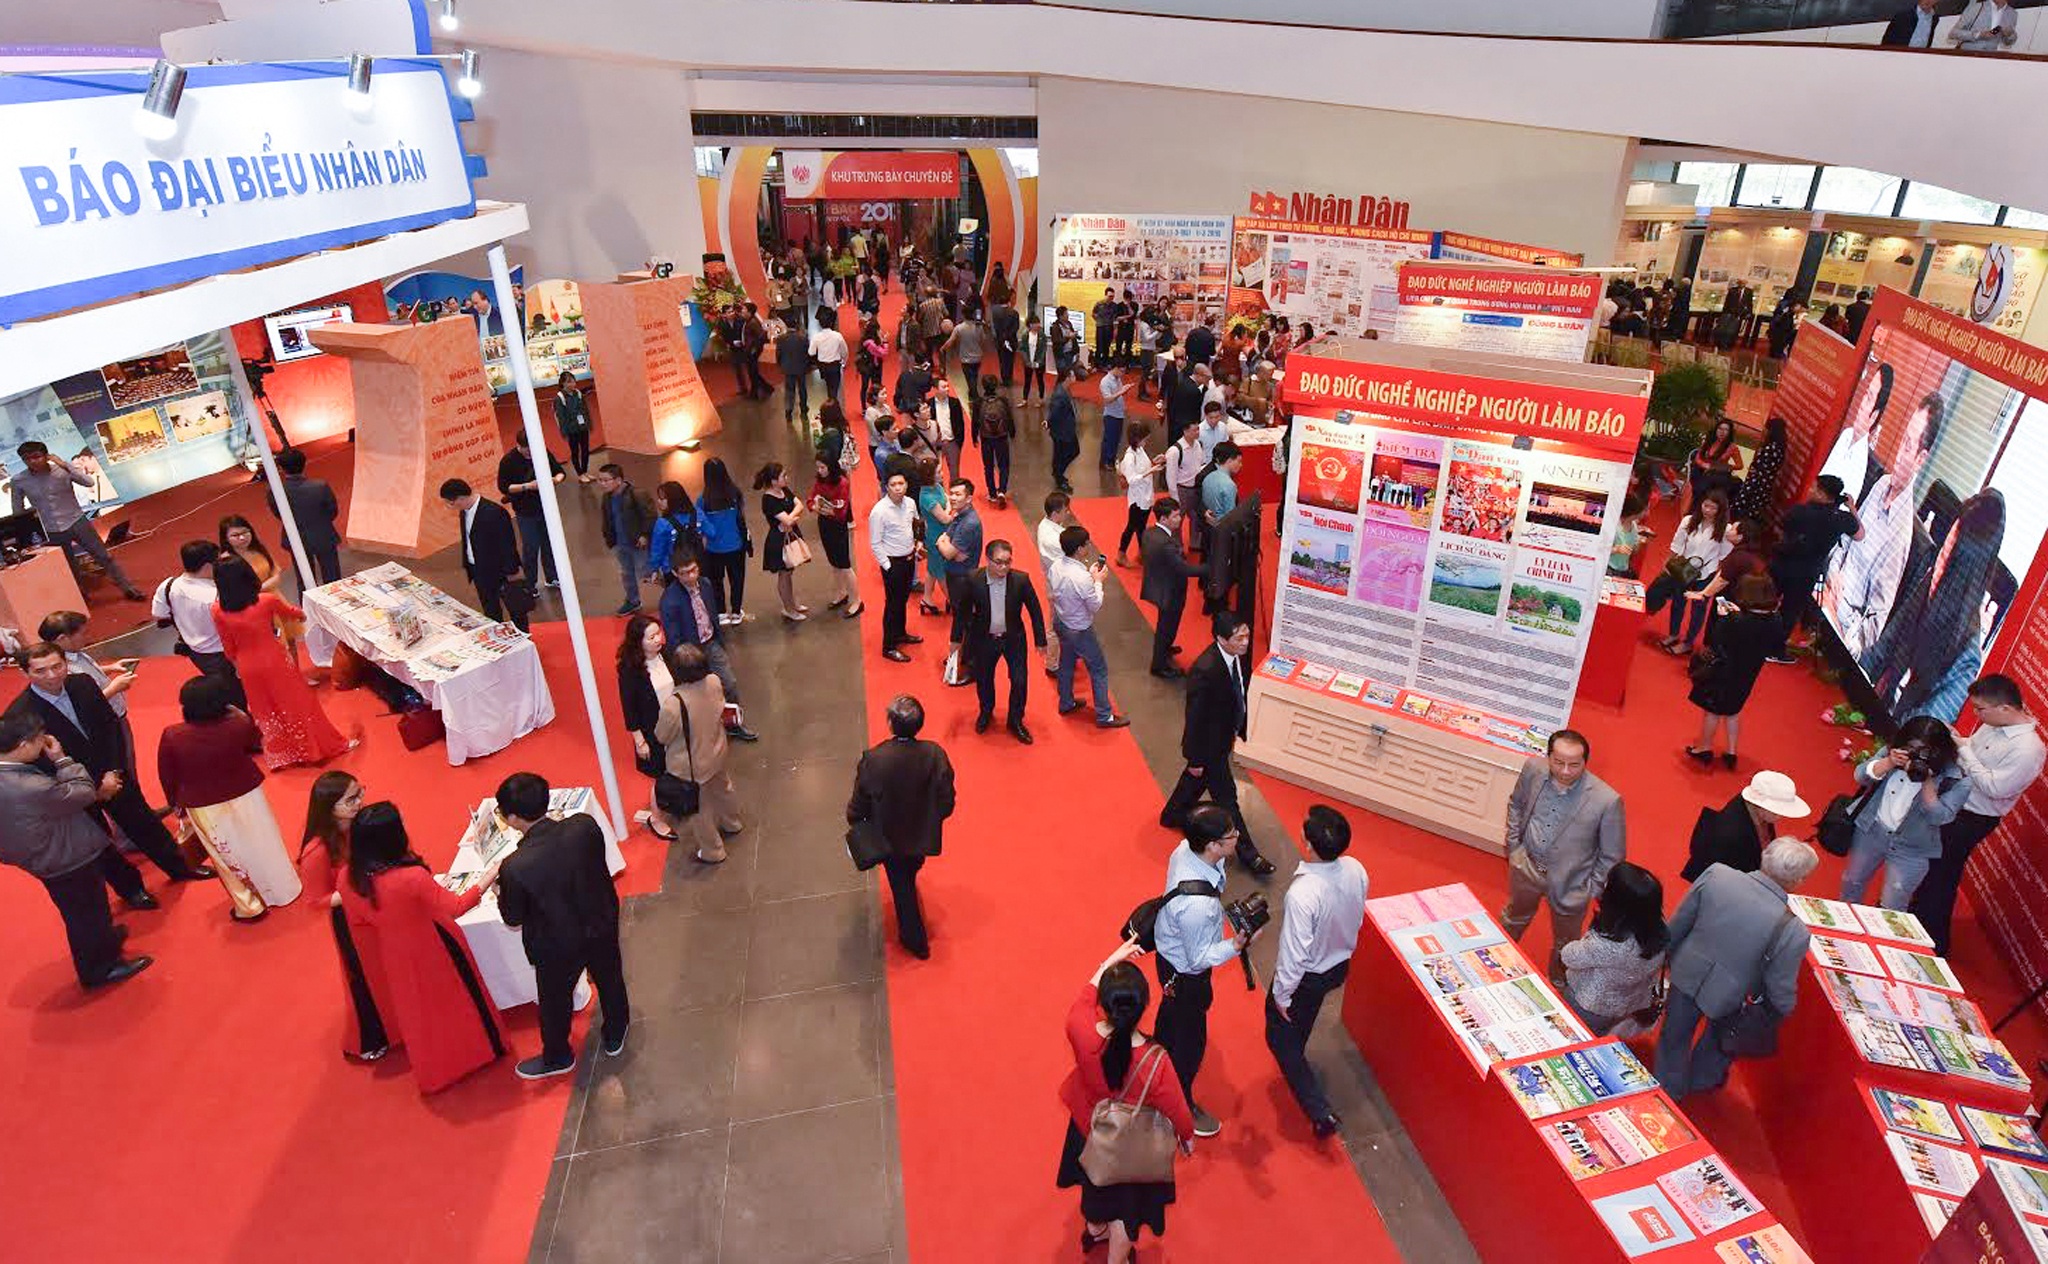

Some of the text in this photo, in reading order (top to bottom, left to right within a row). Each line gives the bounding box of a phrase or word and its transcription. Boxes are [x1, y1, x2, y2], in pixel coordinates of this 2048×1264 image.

[19, 131, 428, 226] BÁO ĐẠI BIỂU NHÂN DÂN
[831, 171, 851, 182] KHU
[1107, 217, 1126, 229] Dân
[1290, 192, 1411, 230] Nhân Dân
[1408, 275, 1426, 292] ĐẠO
[1428, 275, 1447, 290] ĐỨC
[1475, 278, 1511, 297] NGHIỆP
[1513, 279, 1545, 296] NGƯỜI
[1547, 281, 1568, 297] LÀM
[1569, 282, 1591, 298] BÁO
[1903, 306, 1918, 330] ĐẠO
[1915, 310, 1933, 333] ĐỨC
[1947, 325, 1979, 357] NGHIỆP
[1974, 337, 2005, 367] NGƯỜI
[2002, 348, 2027, 377] LÀM
[2025, 357, 2048, 387] BÁO
[1300, 371, 1330, 400] ĐẠO
[1333, 373, 1366, 400] ĐỨC
[1414, 388, 1477, 421] NGHIỆP
[1479, 395, 1539, 425] NGƯỜI
[1540, 400, 1580, 431] LÀM
[1584, 407, 1625, 437] BÁO
[1978, 1222, 1998, 1259] BAN
